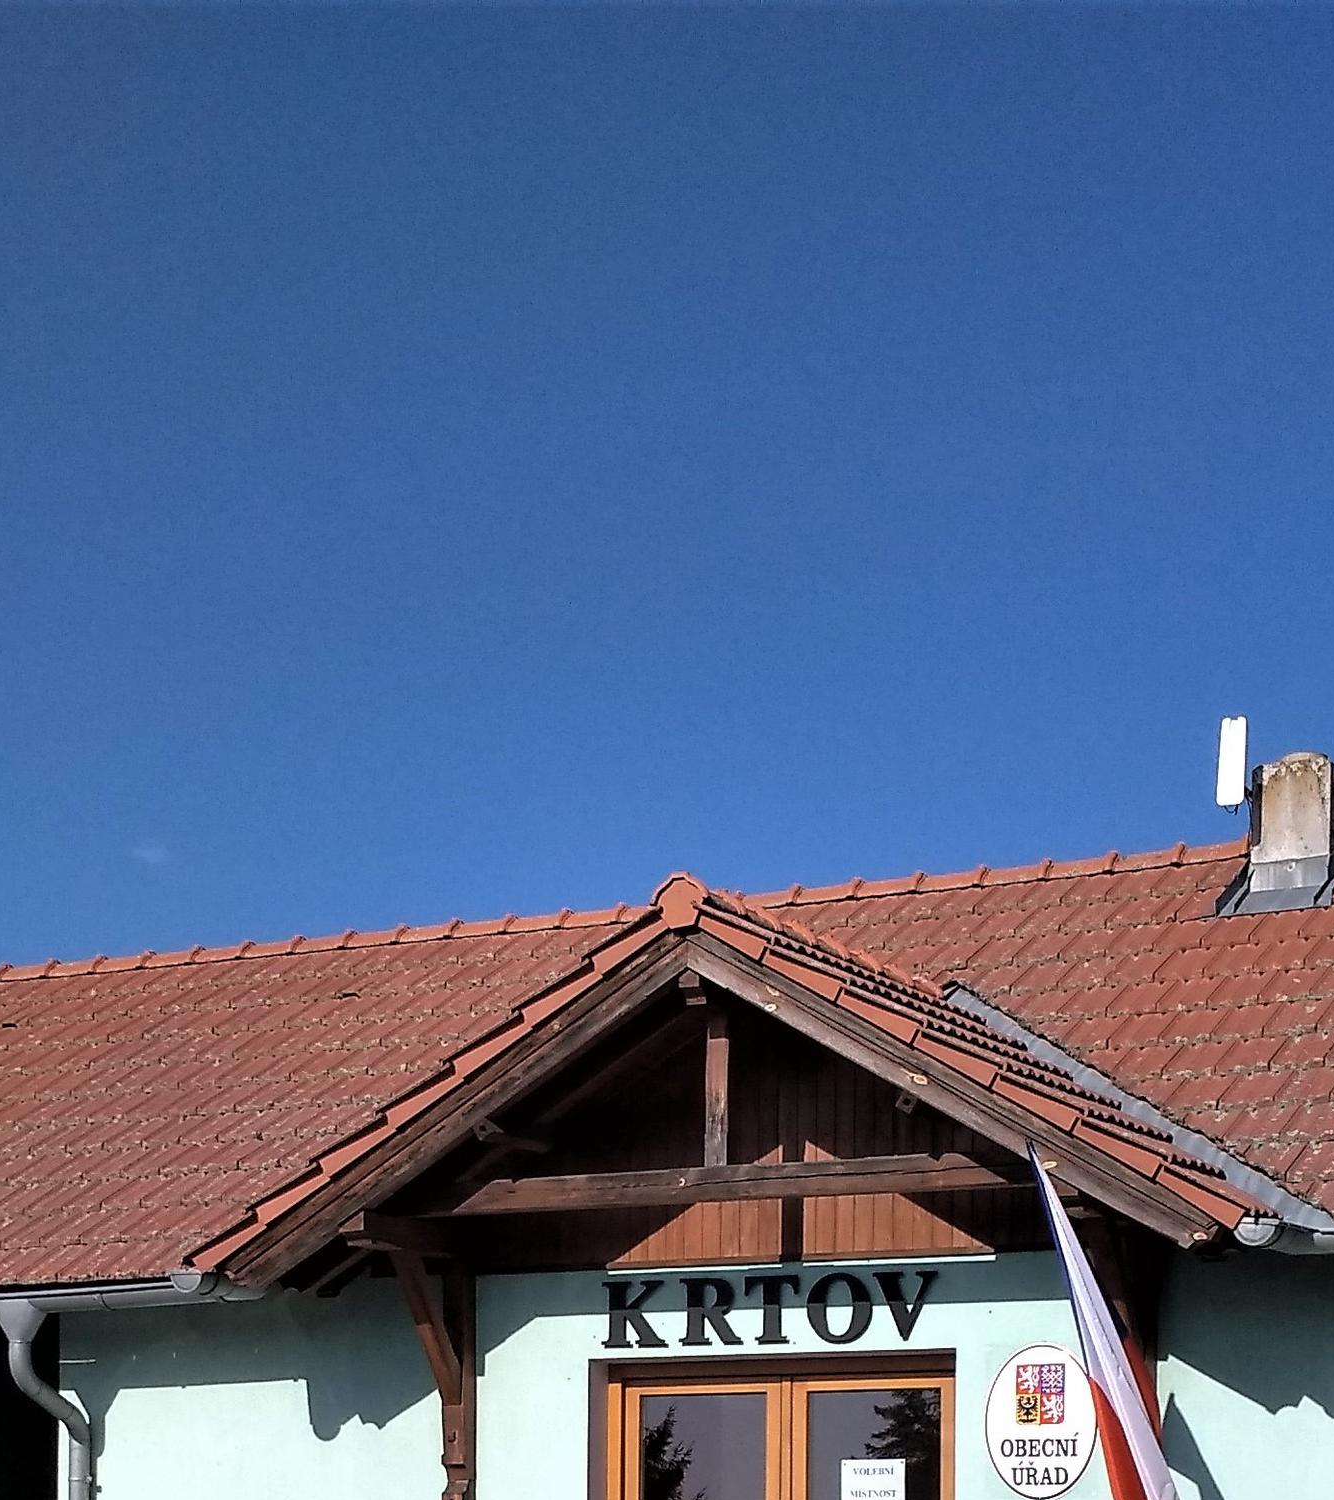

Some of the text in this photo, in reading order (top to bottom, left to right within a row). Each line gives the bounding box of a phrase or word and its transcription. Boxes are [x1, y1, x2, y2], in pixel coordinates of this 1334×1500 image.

[601, 1270, 939, 1349] KRTOV
[1000, 1432, 1079, 1458] OBECNÍ
[853, 1465, 894, 1476] VOLEBNÍ
[1011, 1460, 1069, 1486] ÚŘAD
[850, 1488, 898, 1498] MÍSTNOST
